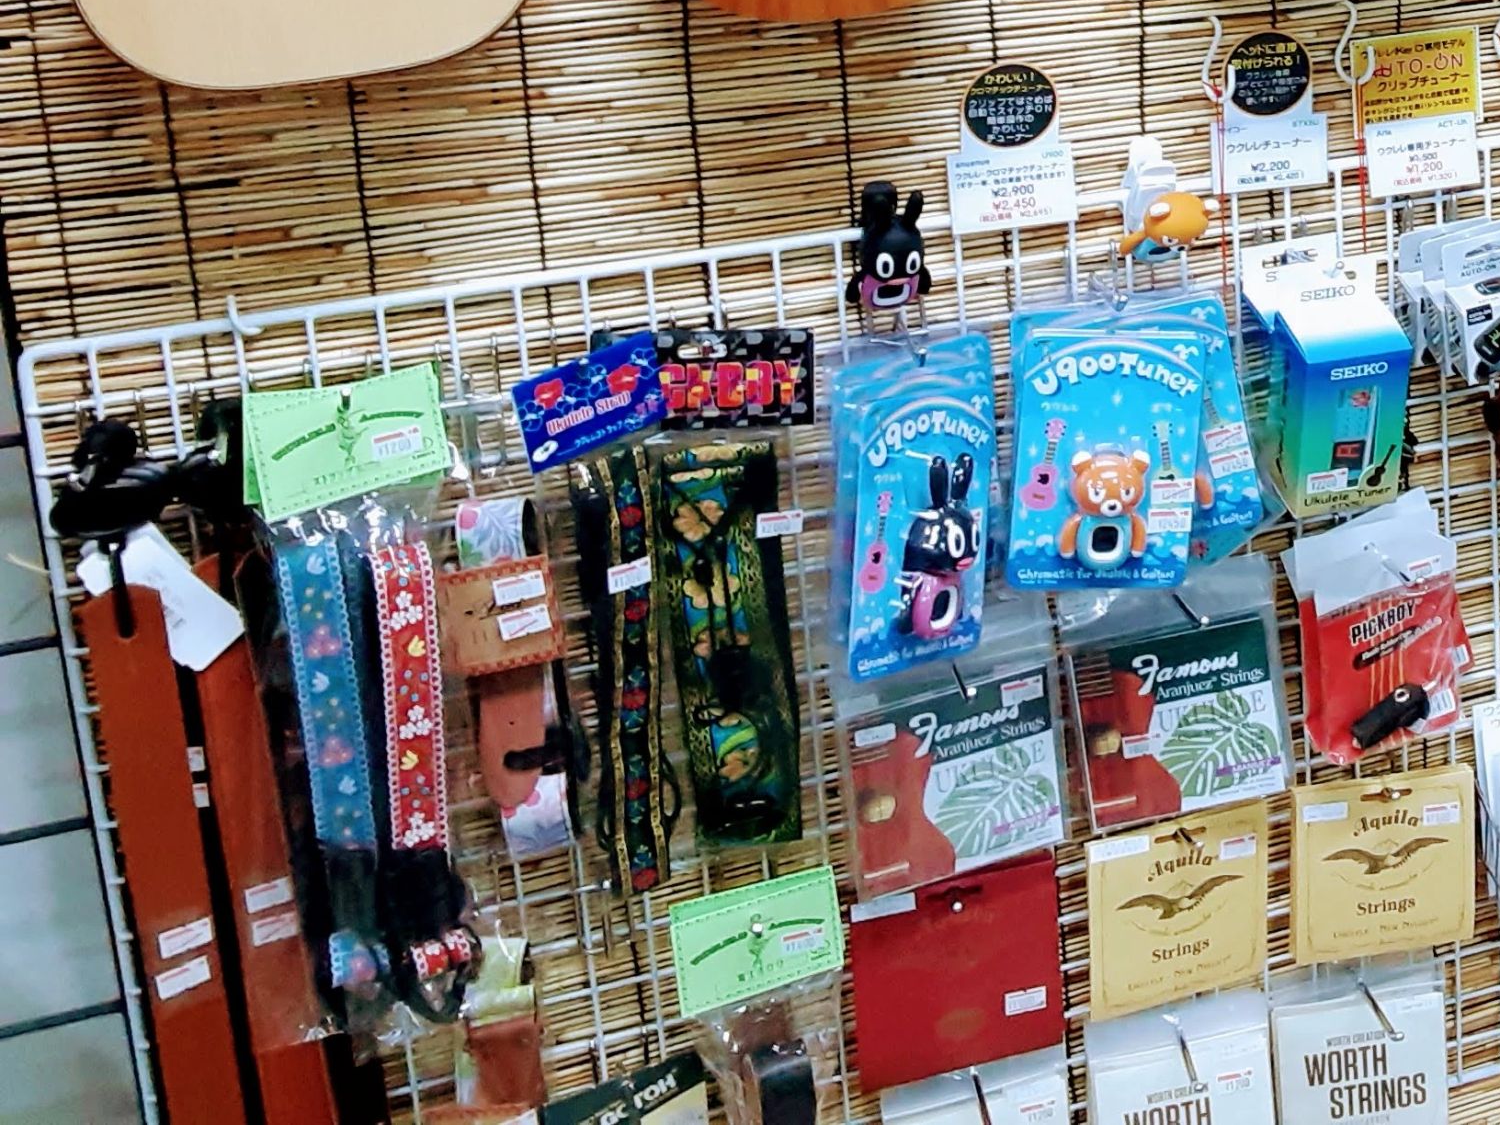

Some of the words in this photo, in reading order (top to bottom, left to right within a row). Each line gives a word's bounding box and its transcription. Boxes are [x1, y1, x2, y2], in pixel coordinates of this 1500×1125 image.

[1377, 72, 1470, 93] クリップチューナー
[986, 132, 1034, 143] チューナー
[992, 123, 1030, 134] かわいい
[1225, 137, 1313, 155] ウクレレチューナー
[1377, 138, 1467, 156] ウクレレ専用チューナー
[1250, 159, 1292, 174] ¥2,200
[1405, 160, 1444, 173] ¥1,200
[992, 184, 1036, 198] ¥2,900
[992, 196, 1037, 211] ¥2,450
[1300, 285, 1356, 303] SEIKO
[1330, 361, 1389, 381] SEIKO
[547, 407, 593, 435] Ukulele
[596, 391, 631, 413] Strap
[1304, 493, 1350, 508] Ukulele
[1357, 485, 1392, 498] Tuner
[1132, 651, 1239, 696] Famous
[1220, 666, 1266, 686] Strings
[908, 702, 1021, 759] Famous
[933, 729, 998, 761] Aranjuez
[1000, 715, 1046, 741] Strings
[1352, 809, 1421, 838] Aquila
[1147, 847, 1215, 884] Aquila
[1356, 894, 1417, 918] Strings
[1151, 936, 1211, 965] Strings
[1326, 1033, 1352, 1049] WORTH
[1304, 1043, 1388, 1088] WORTH
[1329, 1072, 1428, 1120] STRINGS
